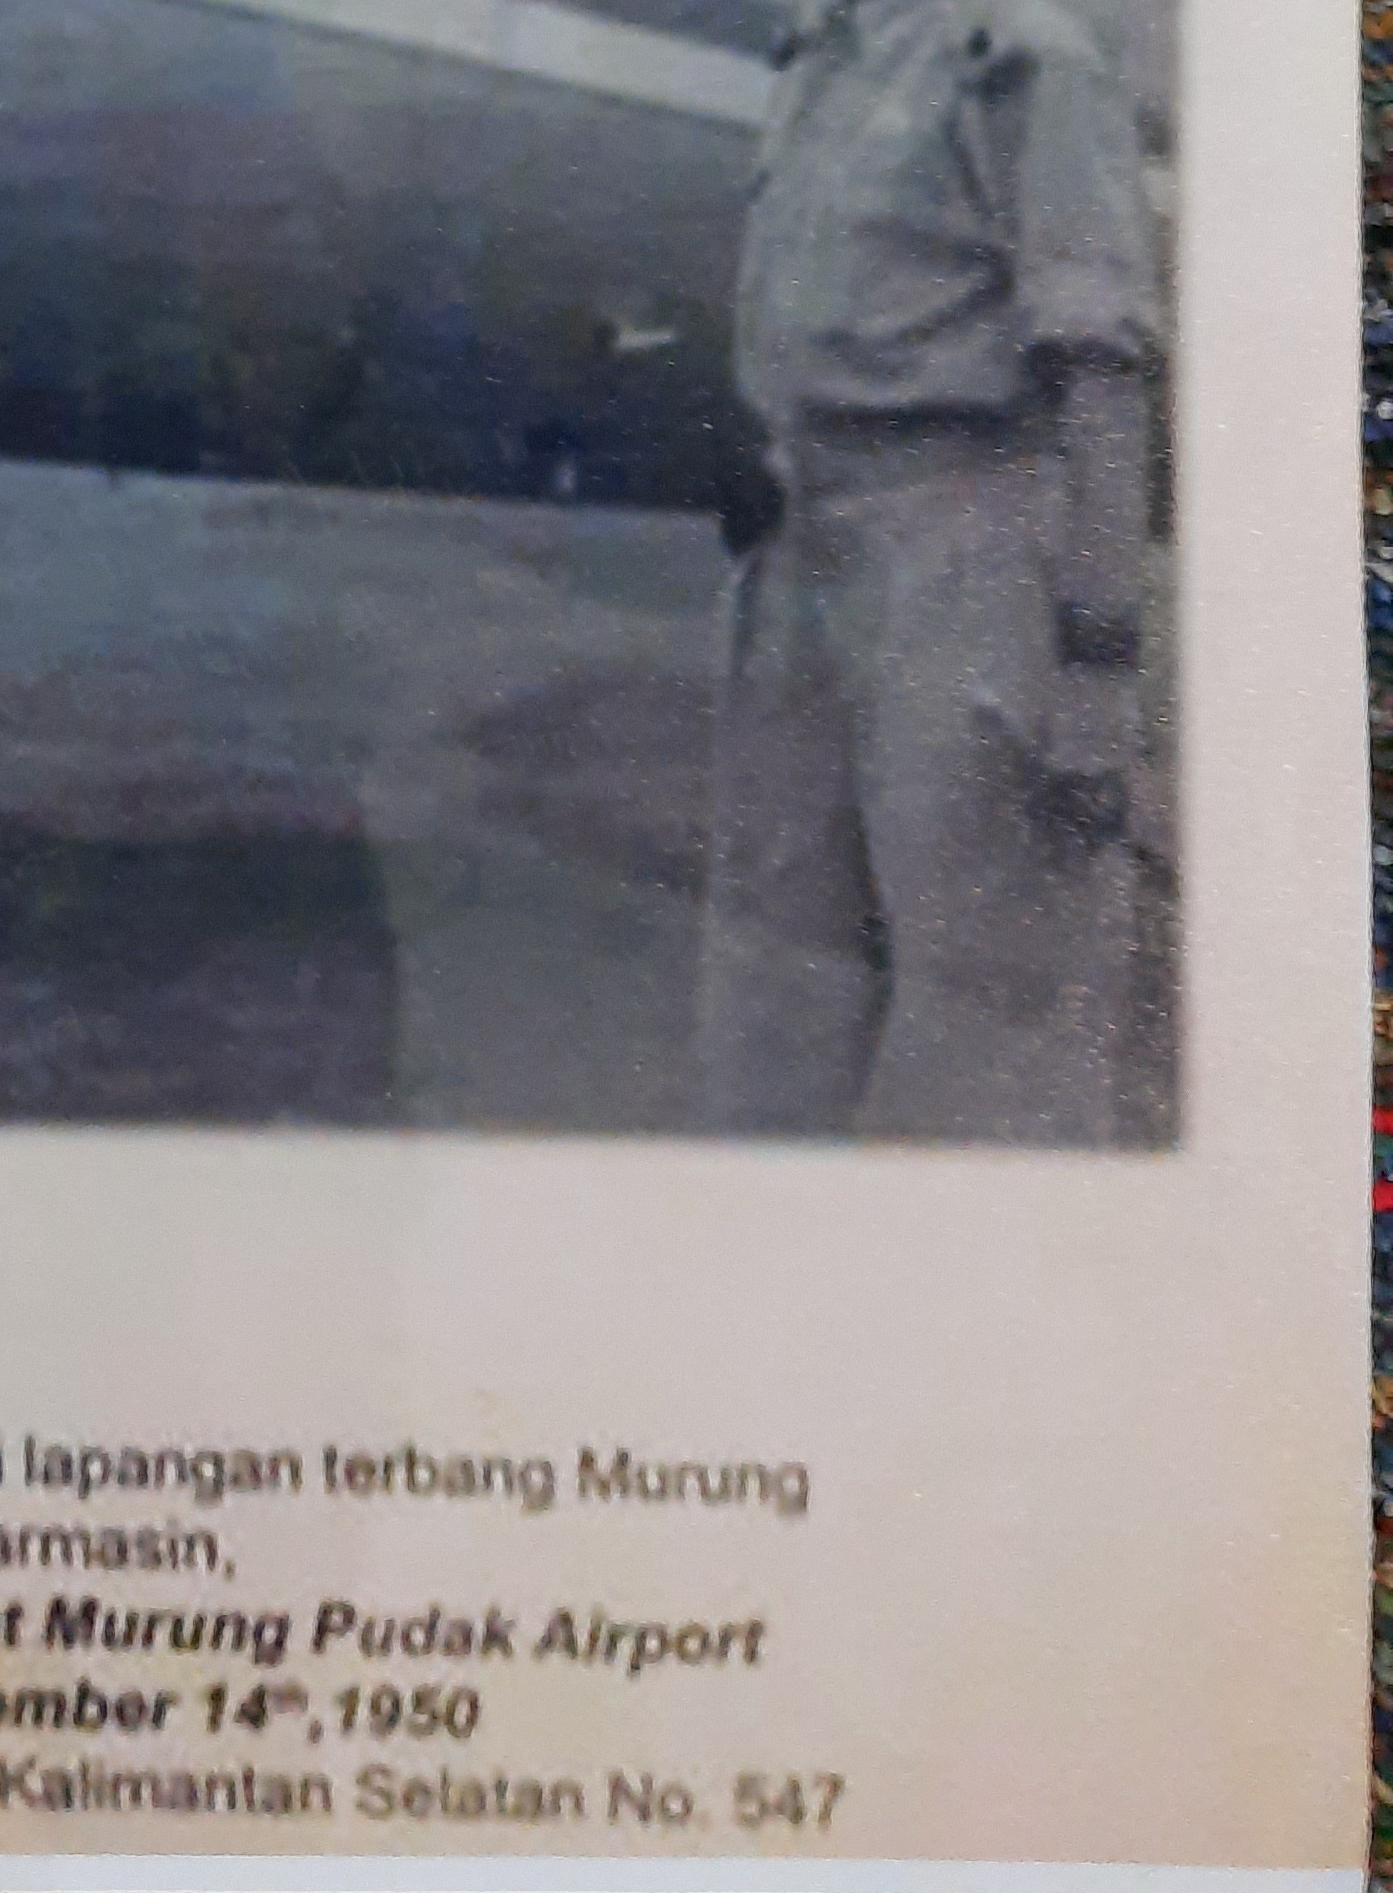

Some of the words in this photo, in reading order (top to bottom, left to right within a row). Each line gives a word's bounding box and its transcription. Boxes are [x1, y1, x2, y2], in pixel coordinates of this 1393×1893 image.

[22, 1434, 304, 1506] lapangan
[322, 1440, 557, 1515] terbang
[576, 1445, 811, 1514] Murung
[41, 1595, 293, 1668] Murung
[311, 1598, 517, 1660] Pudak
[531, 1607, 769, 1679] Airport
[354, 1764, 589, 1827] Selatan
[606, 1770, 709, 1833] No.
[732, 1771, 848, 1836] 547
